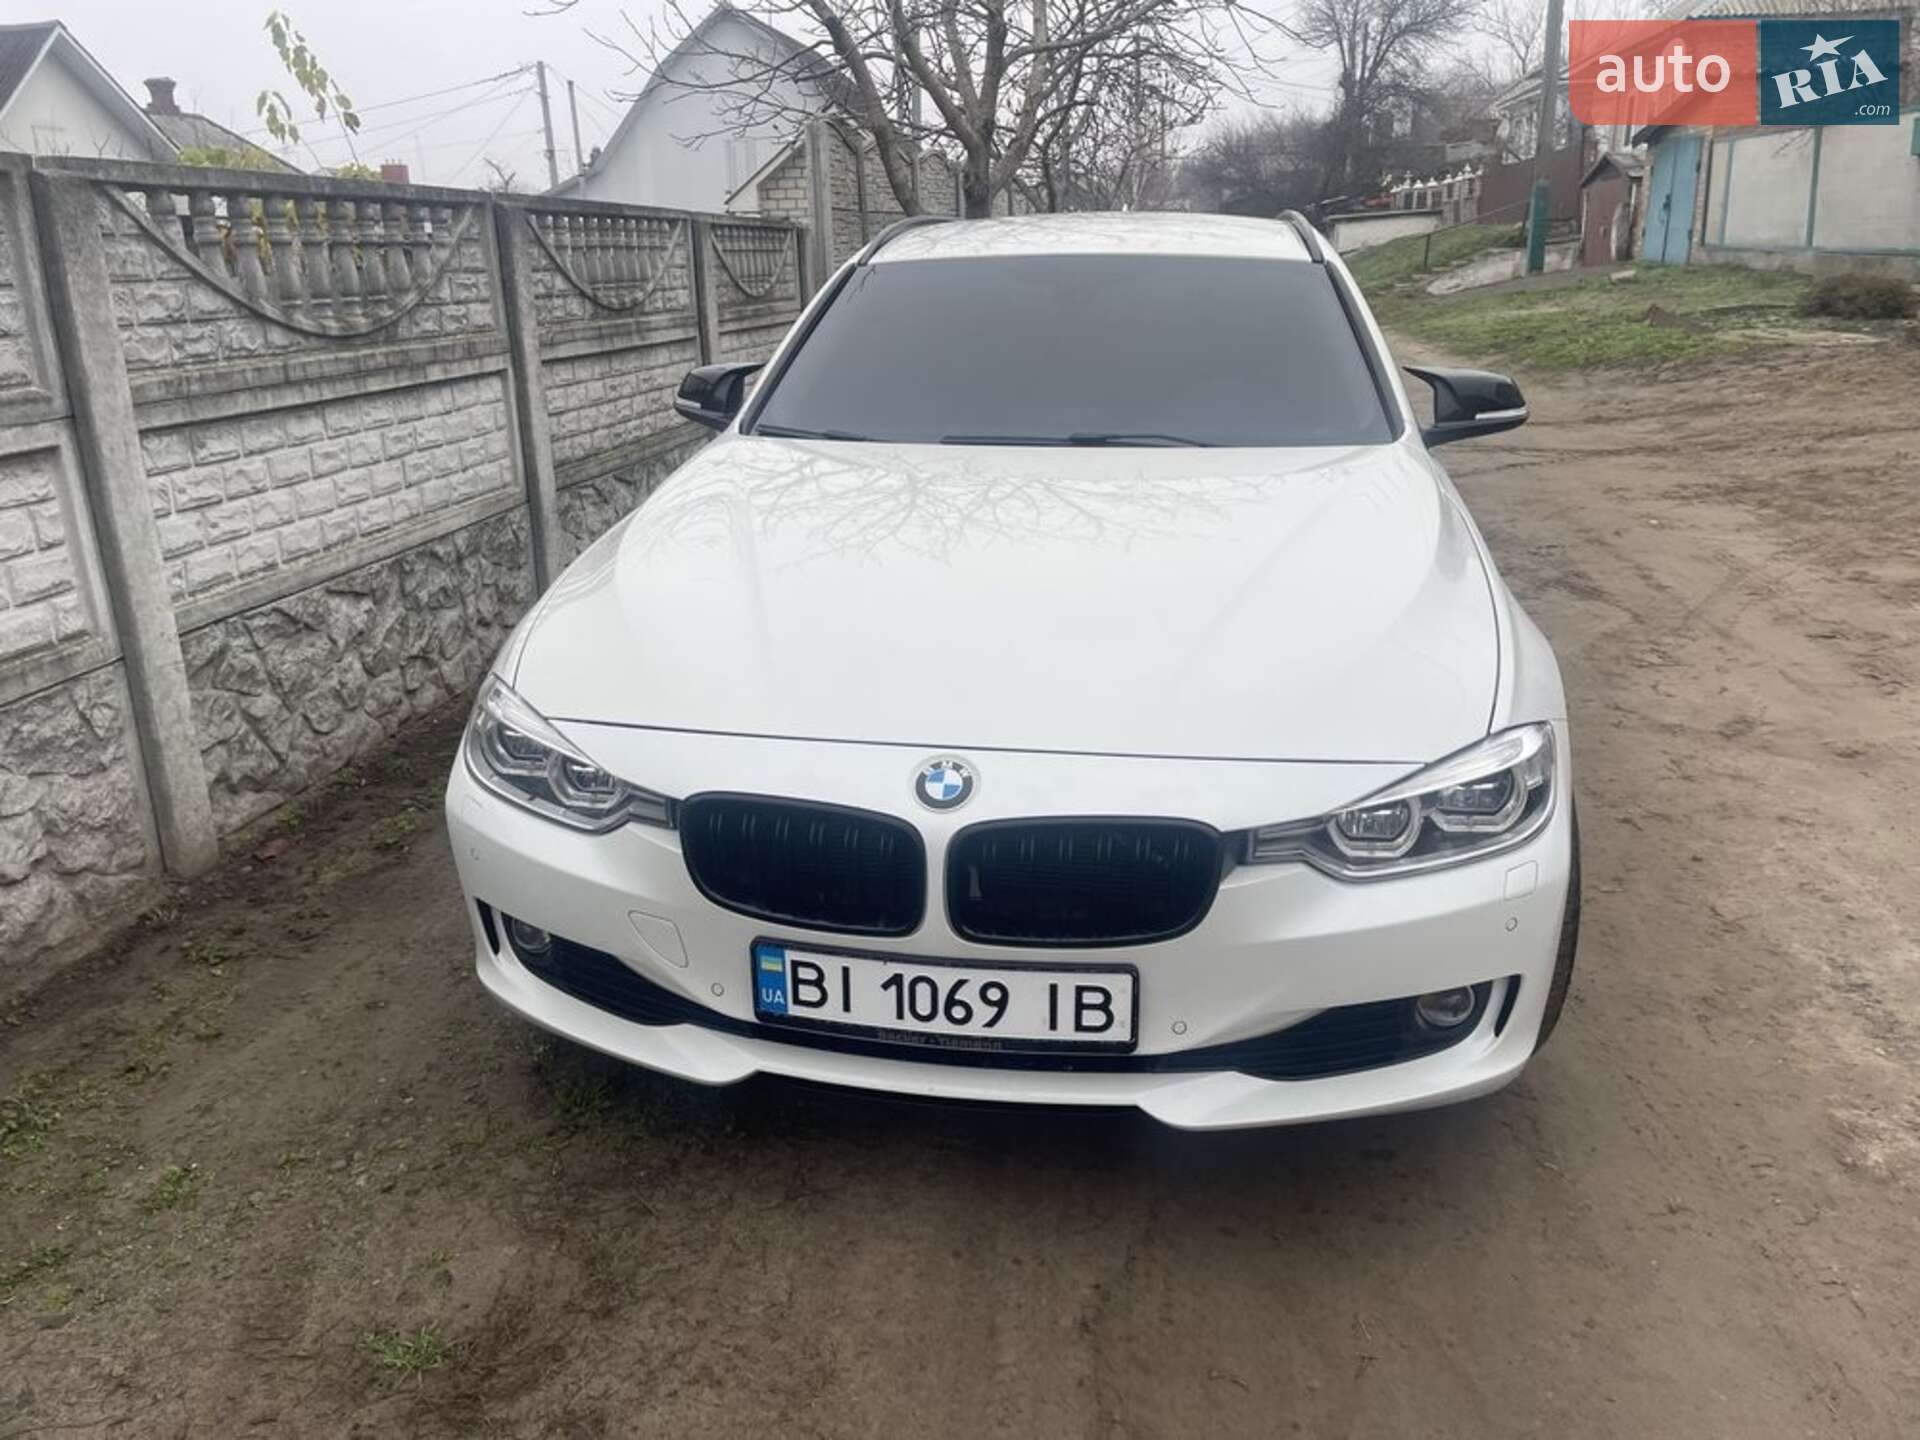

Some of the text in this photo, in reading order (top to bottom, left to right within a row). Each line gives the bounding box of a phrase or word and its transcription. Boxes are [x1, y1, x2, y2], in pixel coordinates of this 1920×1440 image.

[761, 987, 785, 1005] UA
[789, 959, 1115, 1034] BI 1069 IB
